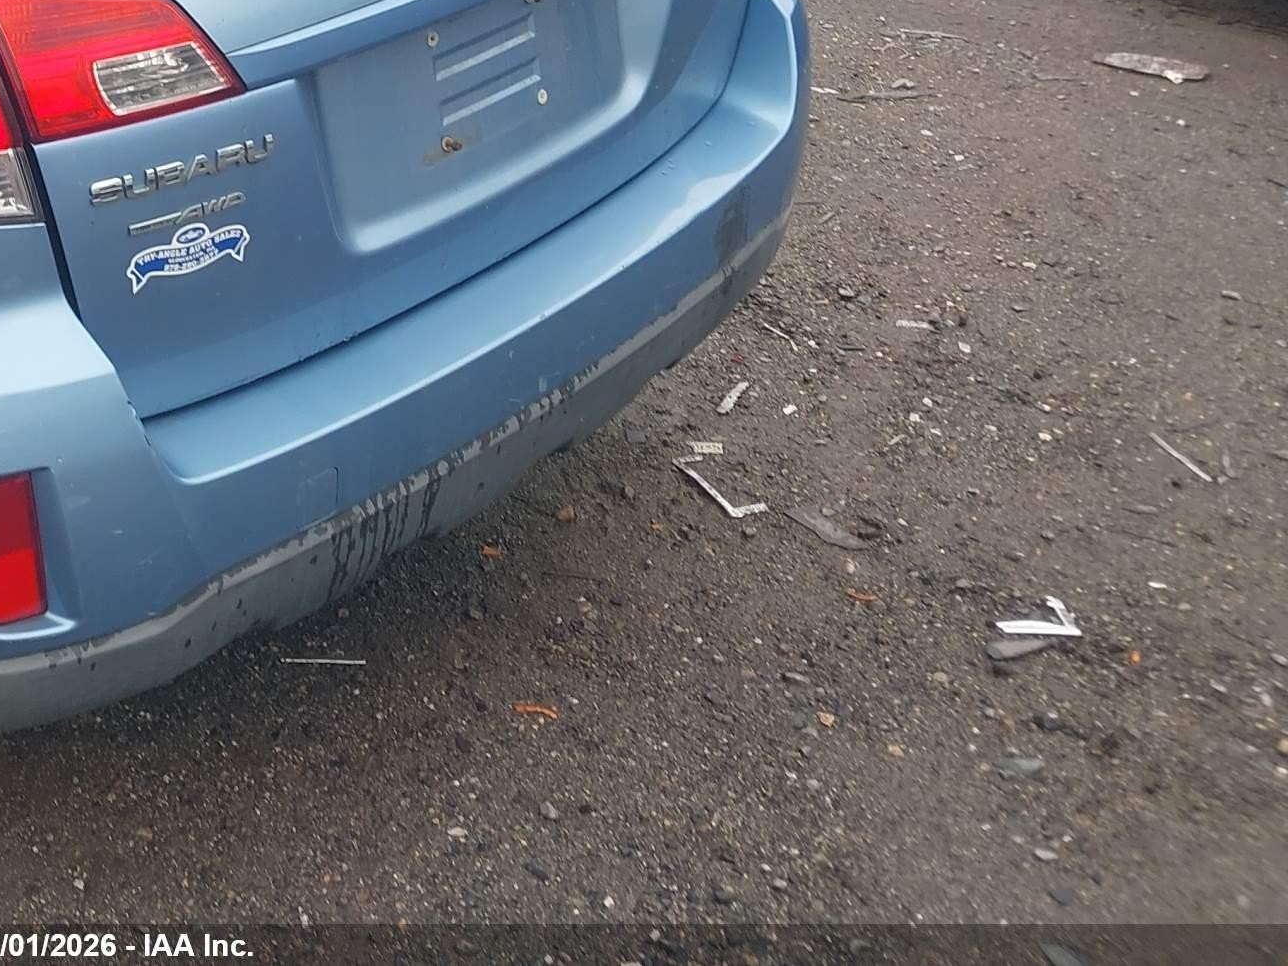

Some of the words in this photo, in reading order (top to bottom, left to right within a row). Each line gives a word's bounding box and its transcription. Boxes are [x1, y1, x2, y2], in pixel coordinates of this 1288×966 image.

[89, 133, 274, 206] SUBARU
[175, 191, 247, 226] AWD
[187, 238, 213, 255] AUTO
[214, 229, 242, 245] SALES
